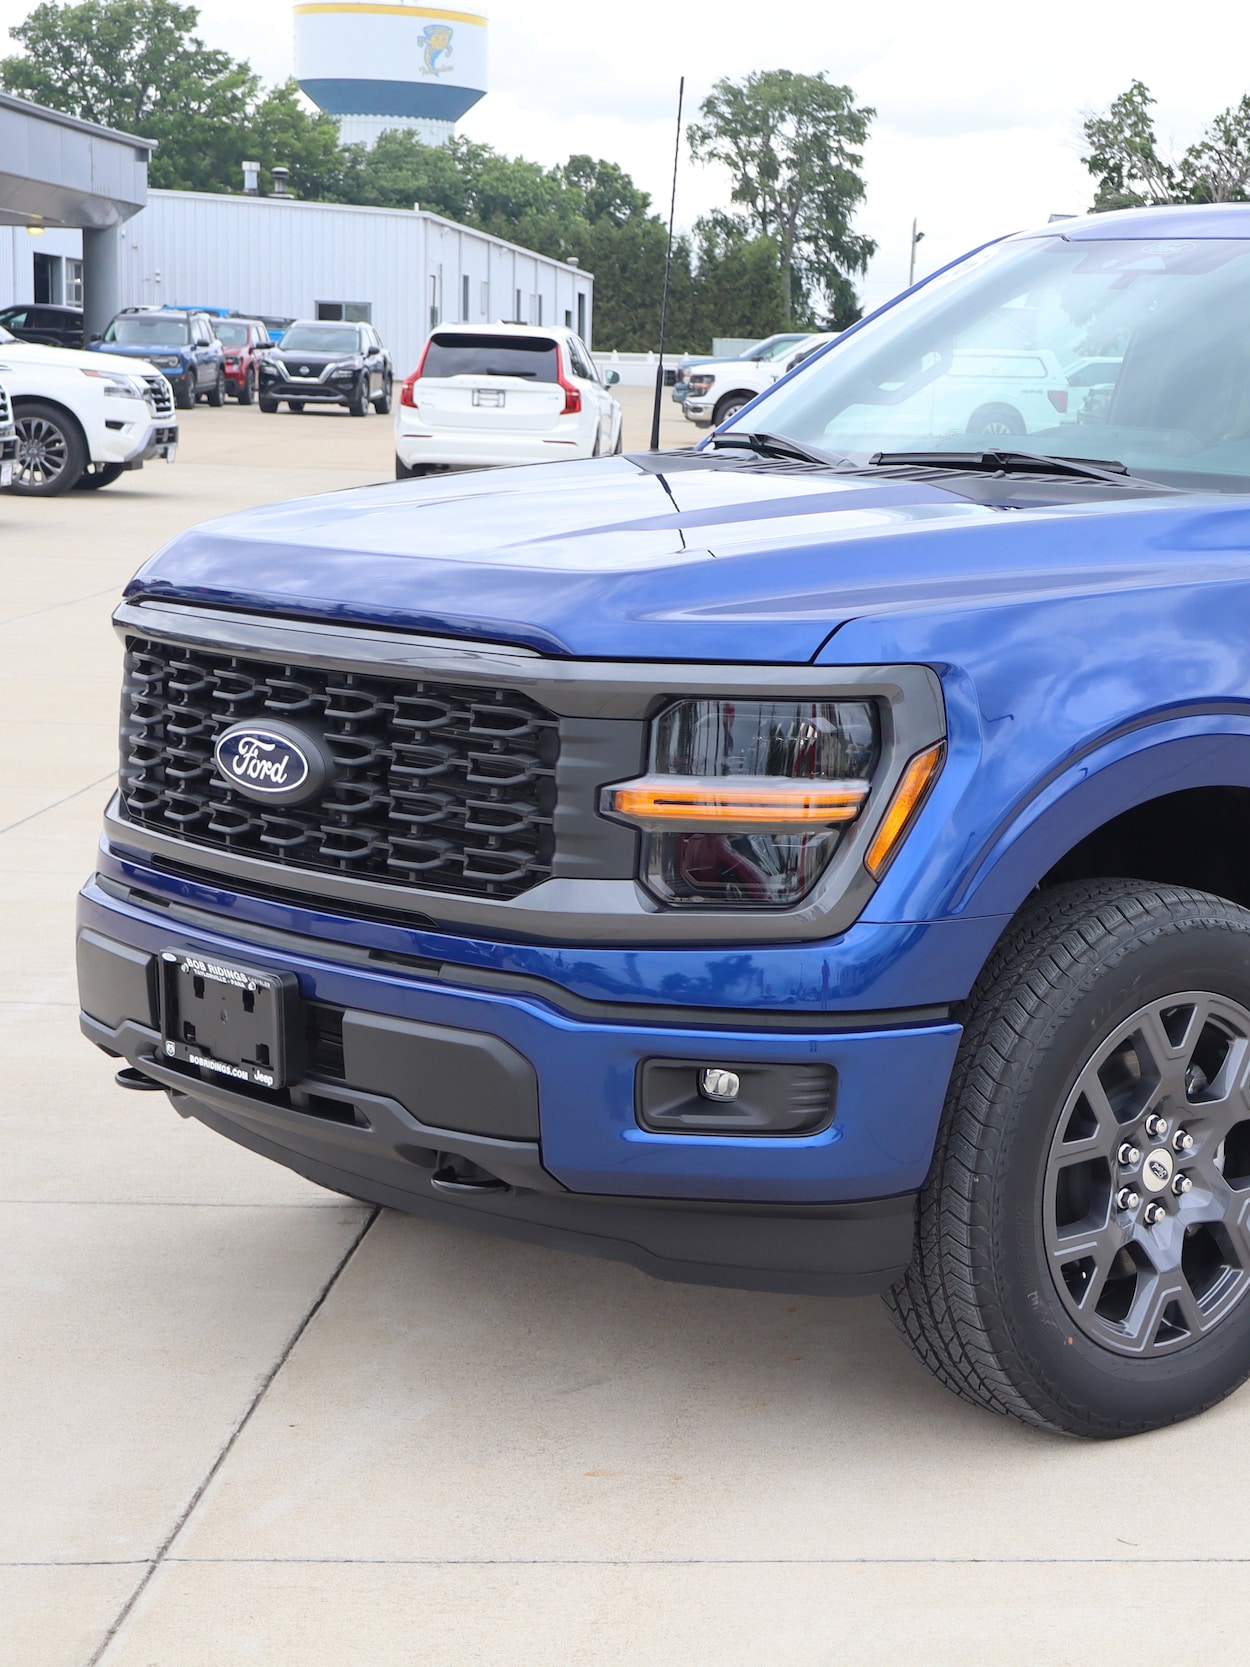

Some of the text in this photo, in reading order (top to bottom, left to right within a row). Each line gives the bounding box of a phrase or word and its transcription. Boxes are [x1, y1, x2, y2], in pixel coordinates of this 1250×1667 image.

[232, 736, 290, 784] Ford
[186, 957, 248, 983] BOB RIDINGS
[189, 1054, 248, 1080] BOBRIDINGS.COM
[254, 1070, 274, 1086] Jeep
